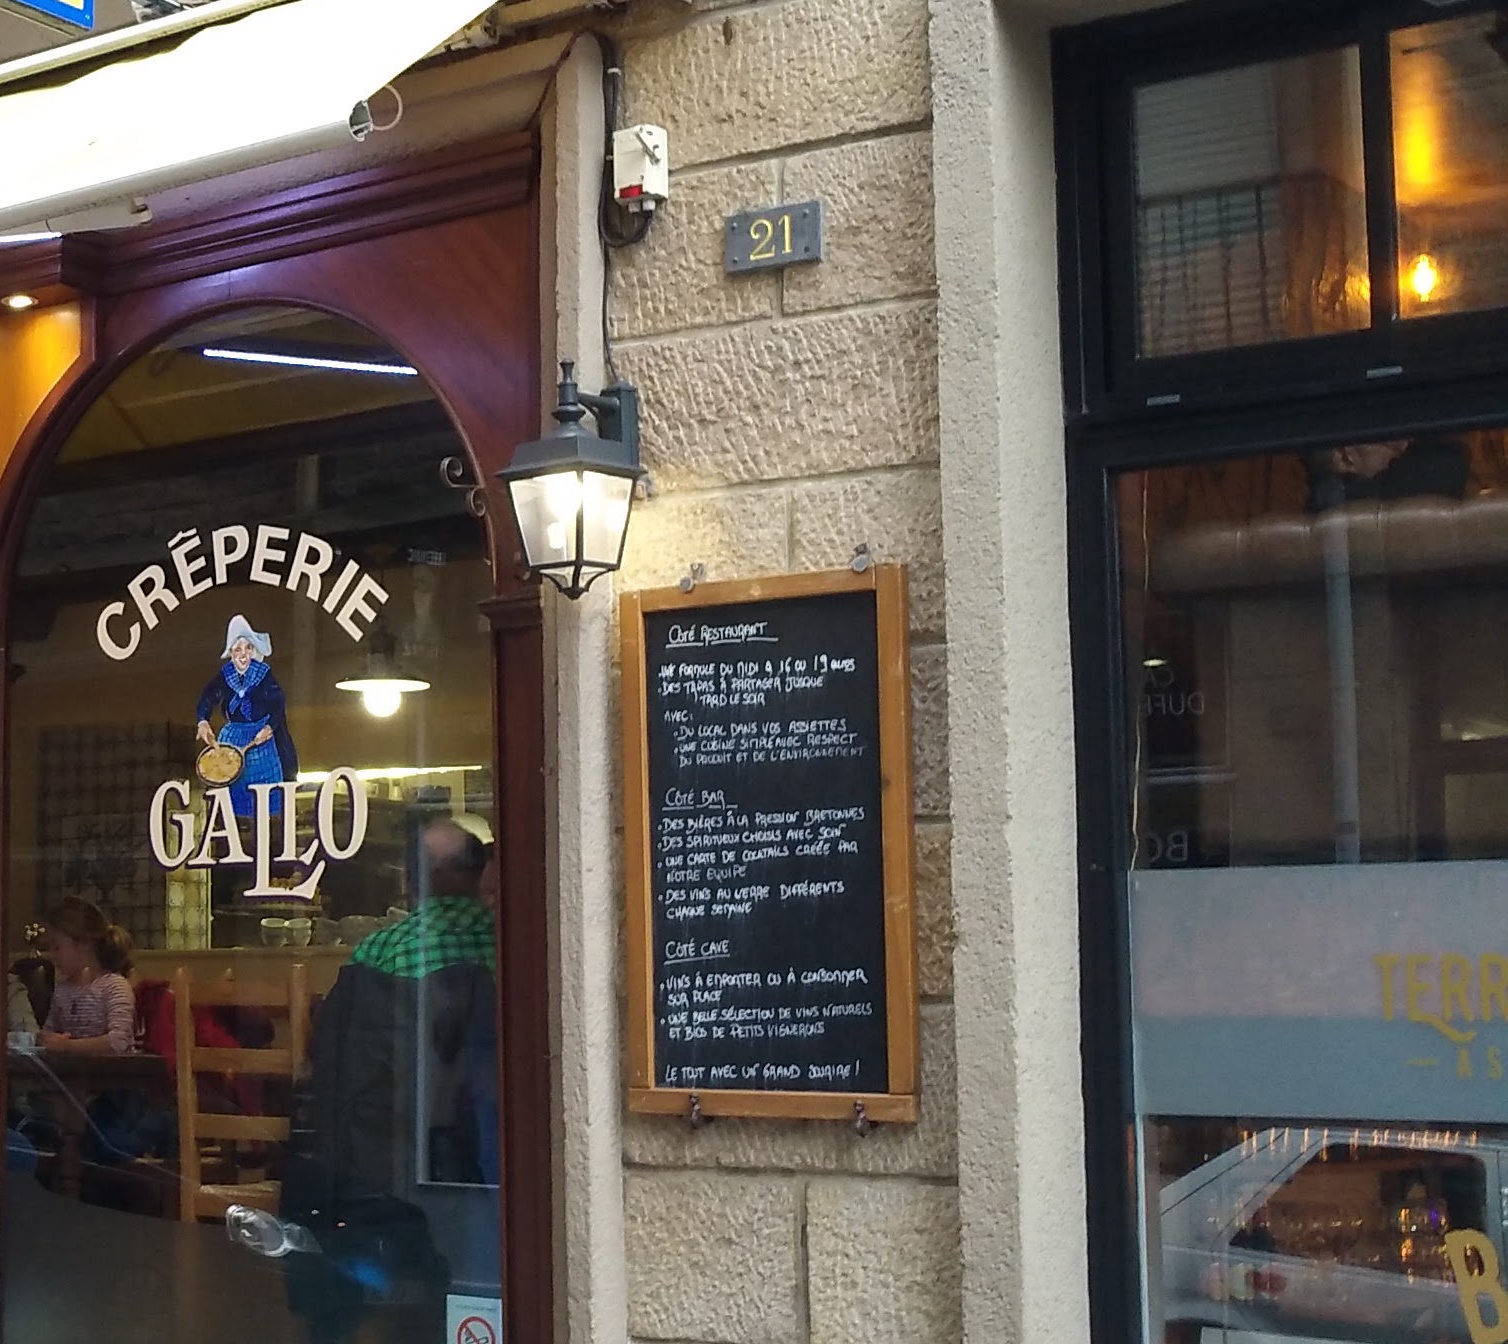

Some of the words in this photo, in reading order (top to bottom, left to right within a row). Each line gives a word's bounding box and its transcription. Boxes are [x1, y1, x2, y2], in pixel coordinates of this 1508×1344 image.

[750, 214, 792, 261] 21
[96, 524, 390, 661] CRÊPERIE
[720, 661, 733, 676] DU
[737, 660, 759, 677] MIDI
[779, 657, 792, 674] 16
[813, 654, 828, 674] 19
[661, 678, 681, 697] DES
[731, 675, 782, 694] PARTAGER
[785, 673, 824, 692] JUSQUE
[699, 692, 727, 708] TARD
[729, 692, 741, 706] LE
[742, 691, 766, 707] SOIR
[676, 725, 695, 742] DU
[697, 722, 727, 738] LOCAL
[730, 721, 758, 737] DANS
[761, 720, 782, 735] VOS
[775, 733, 802, 748] AVEC
[806, 732, 858, 747] RESPECT
[679, 754, 693, 769] DU
[735, 750, 749, 764] ET
[752, 749, 766, 763] DE
[700, 789, 727, 810] BAR
[661, 816, 685, 835] DES
[736, 812, 750, 828] LA
[754, 810, 801, 828] PRESSION
[803, 806, 866, 827] BRETONNES
[148, 766, 368, 900] GALLO
[662, 835, 683, 853] DES
[686, 832, 741, 850] SPIRITUEUX
[742, 829, 783, 845] CHOISIS
[785, 827, 814, 842] AVEC
[817, 822, 847, 840] SOIN
[686, 851, 717, 868] CARTE
[721, 849, 737, 864] DE
[837, 839, 859, 855] PAR
[666, 868, 701, 884] NOTRE
[664, 887, 687, 906] DES
[690, 887, 712, 902] VINS
[716, 886, 732, 901] AU
[733, 884, 771, 903] VERRE
[700, 939, 730, 957] CAVE
[665, 973, 691, 992] VINS
[706, 970, 762, 989] EMPORTER
[766, 972, 782, 986] OU
[667, 991, 690, 1008] SUR
[692, 988, 723, 1005] PLACE
[691, 1008, 718, 1026] BELLE
[778, 1006, 792, 1020] DE
[795, 1005, 820, 1019] VINS
[822, 1002, 873, 1018] NATURELS
[668, 1025, 681, 1040] ET
[712, 1025, 726, 1040] DE
[728, 1023, 765, 1040] PETITS
[767, 1020, 826, 1037] VIGNERONS
[665, 1064, 678, 1082] LE
[680, 1063, 706, 1080] TOUT
[709, 1063, 738, 1079] AVEC
[742, 1062, 761, 1079] UN
[762, 1063, 801, 1082] GRAND
[808, 1063, 852, 1081] SOURIRE
